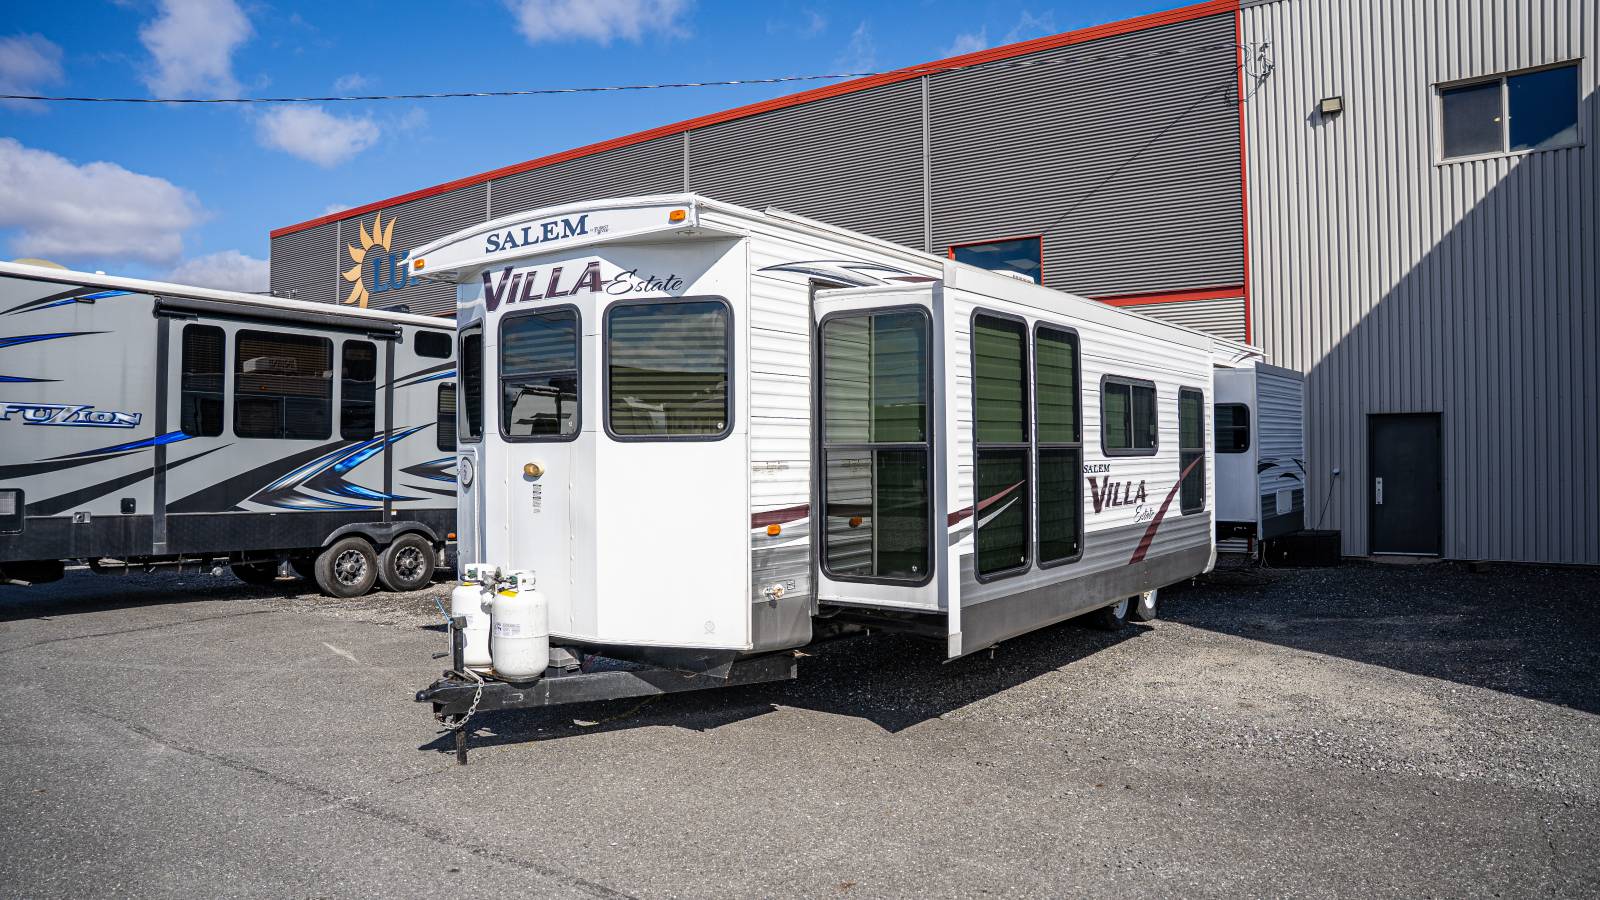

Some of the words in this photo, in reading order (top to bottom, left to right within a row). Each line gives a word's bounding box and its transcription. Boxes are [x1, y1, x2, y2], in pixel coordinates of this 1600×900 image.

[485, 214, 589, 254] SALEM
[482, 261, 604, 312] VILLA
[606, 269, 683, 296] Estate
[1083, 464, 1110, 474] SALEM
[1087, 475, 1147, 513] VILLA
